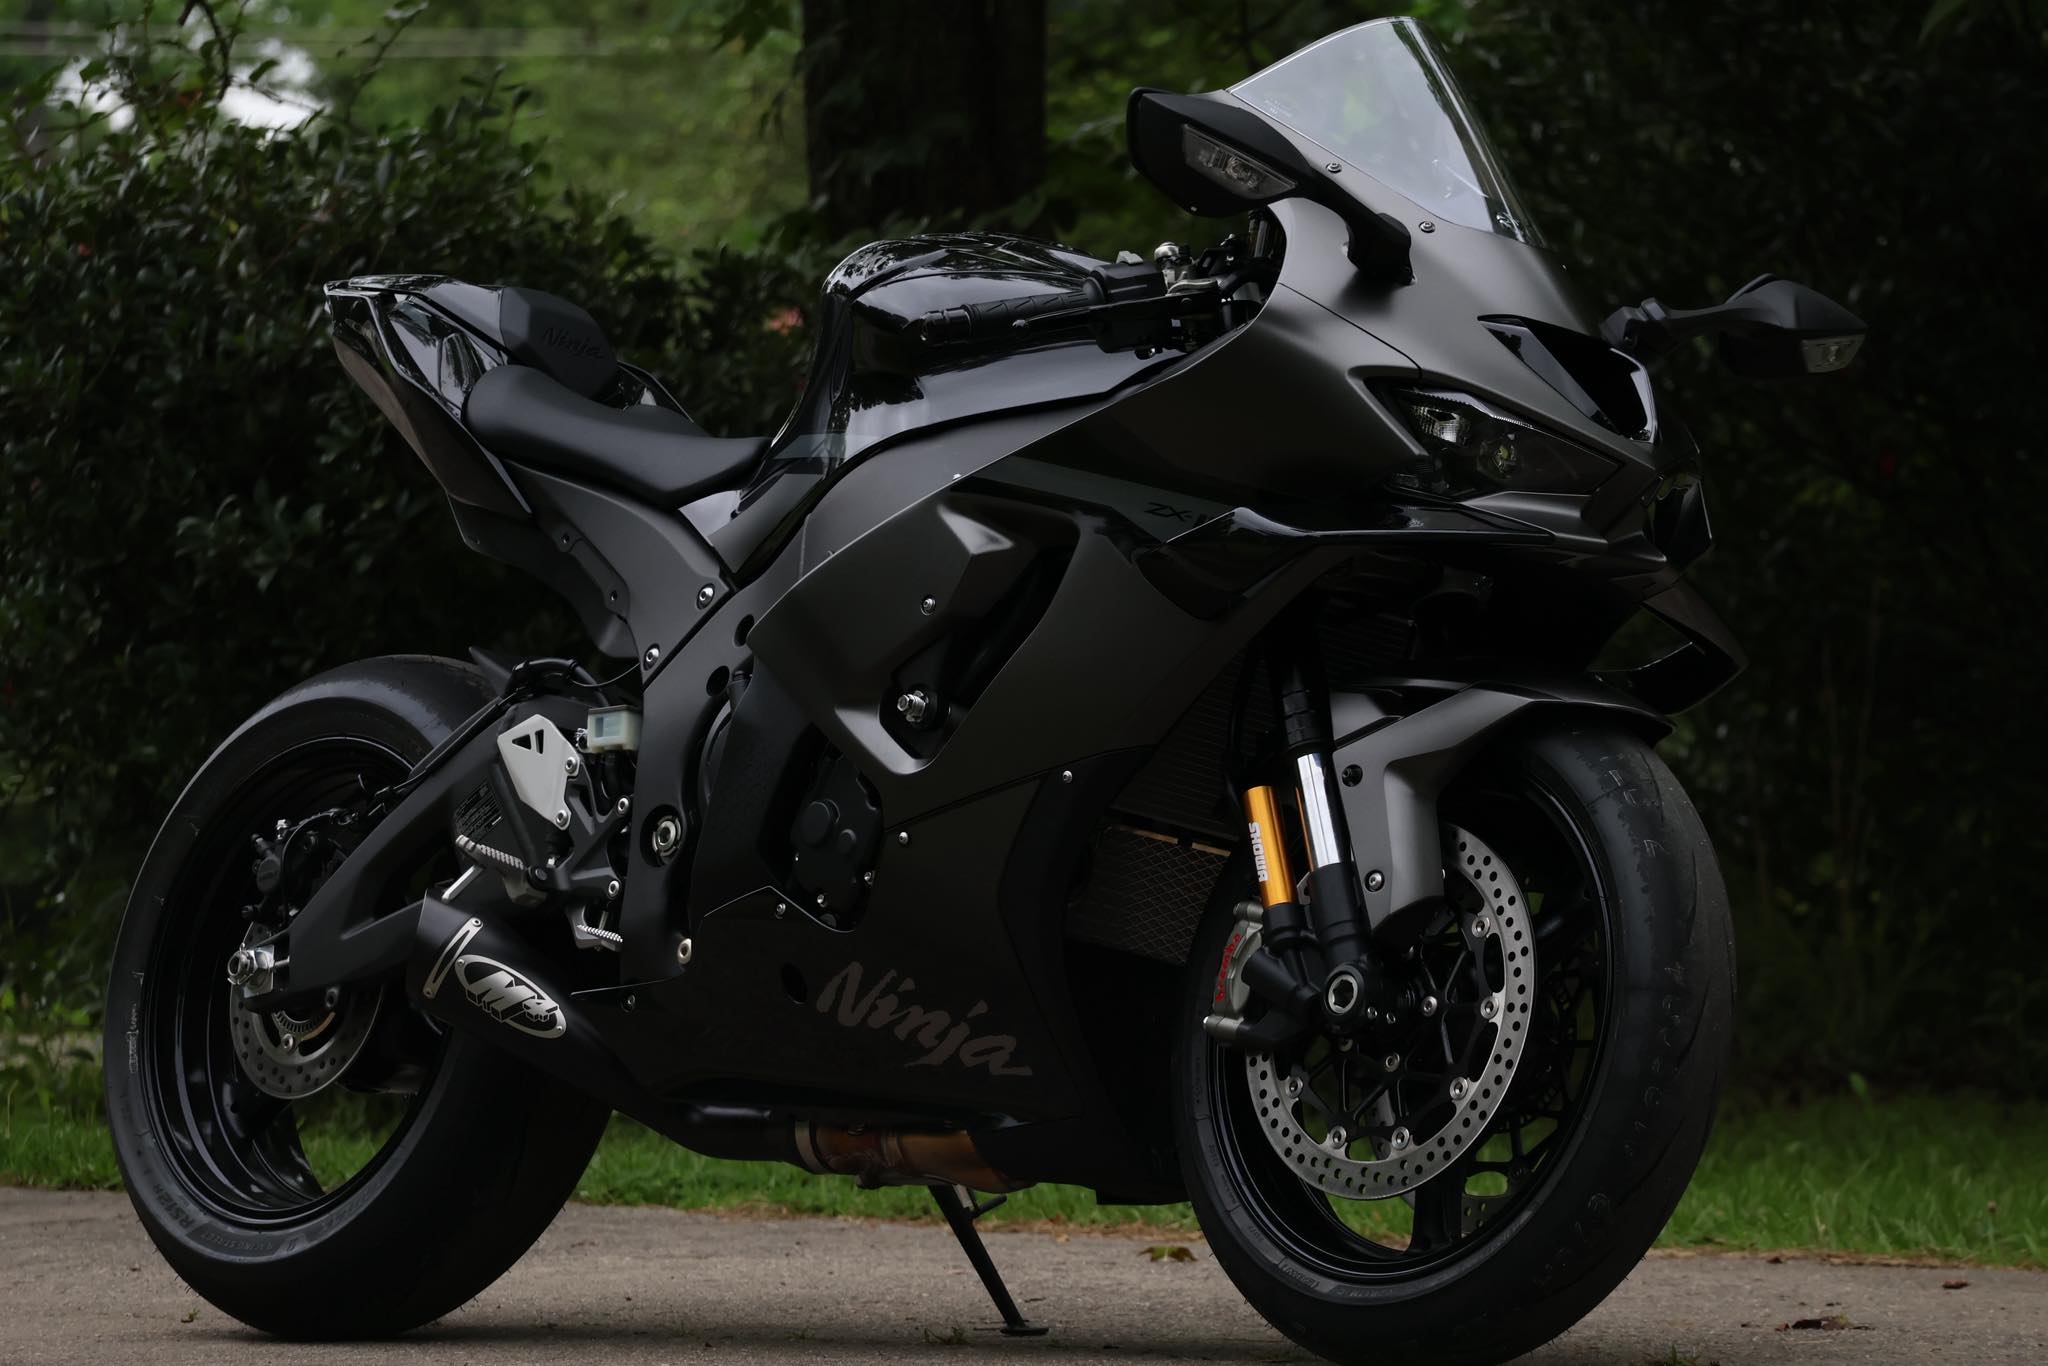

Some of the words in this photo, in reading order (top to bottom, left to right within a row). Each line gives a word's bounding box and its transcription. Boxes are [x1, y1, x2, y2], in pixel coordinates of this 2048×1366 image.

[543, 327, 605, 359] Ninja
[1248, 821, 1268, 883] SHOWA
[466, 970, 560, 1023] M4
[1215, 932, 1242, 1002] brembo
[816, 961, 1033, 1076] Ninja
